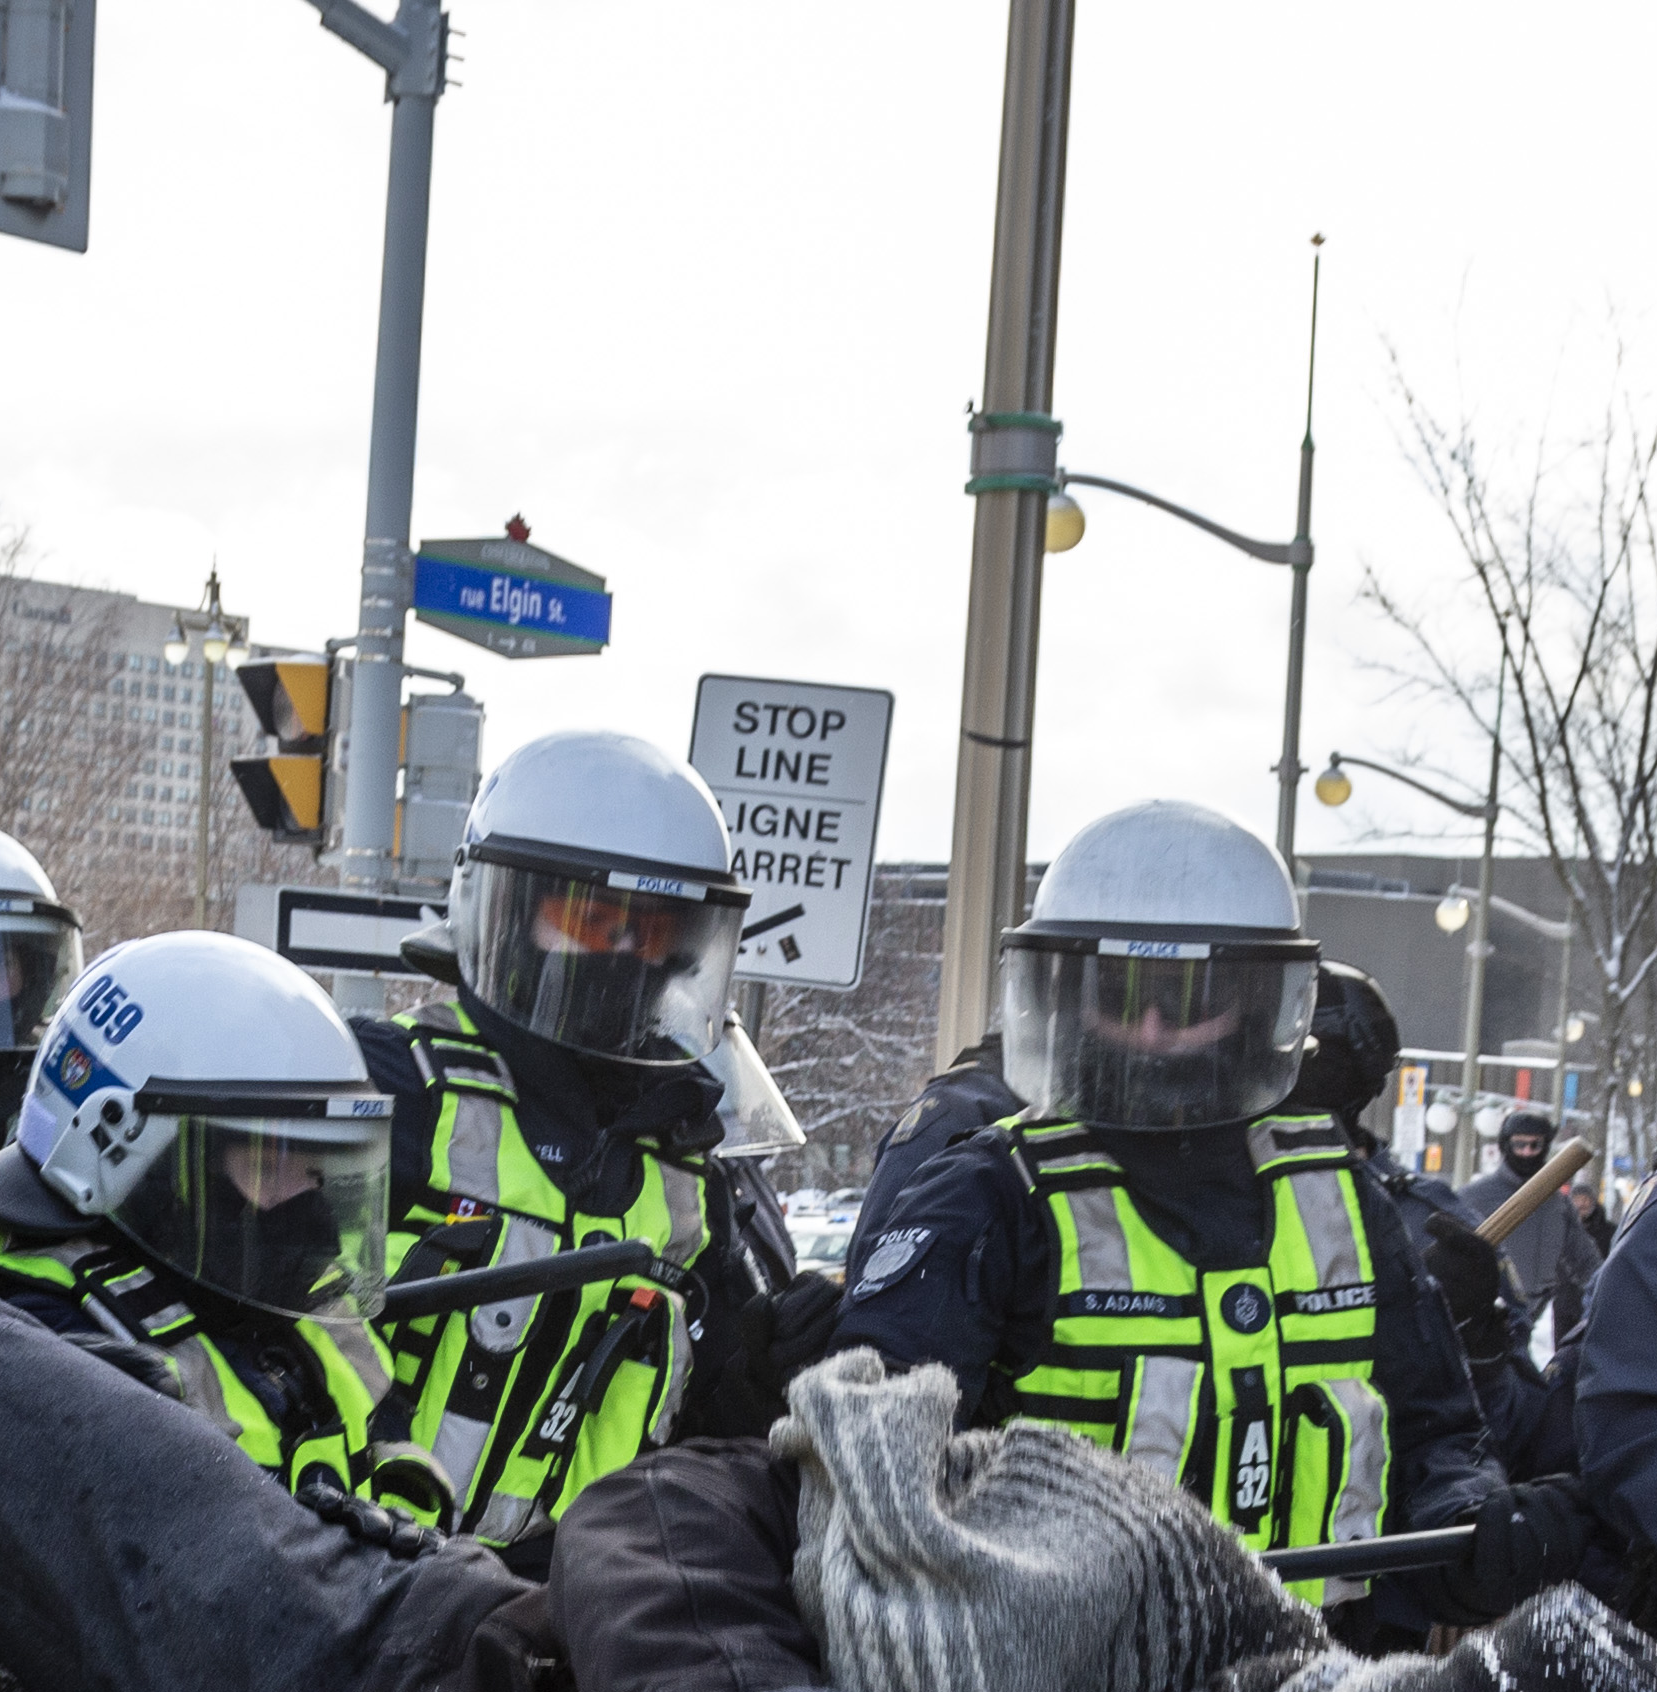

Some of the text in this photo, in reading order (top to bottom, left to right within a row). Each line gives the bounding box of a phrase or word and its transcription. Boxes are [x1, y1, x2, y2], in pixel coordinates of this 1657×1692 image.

[460, 575, 567, 625] rue Elgin St.
[733, 701, 846, 740] STOP
[735, 746, 832, 785] LINE
[77, 974, 144, 1045] 059
[876, 1227, 931, 1249] POLICE
[1085, 1292, 1167, 1313] S. ADAMS
[1296, 1284, 1377, 1312] POLICE
[539, 1400, 579, 1443] 32
[1239, 1420, 1269, 1466] A
[1236, 1464, 1270, 1510] 32
